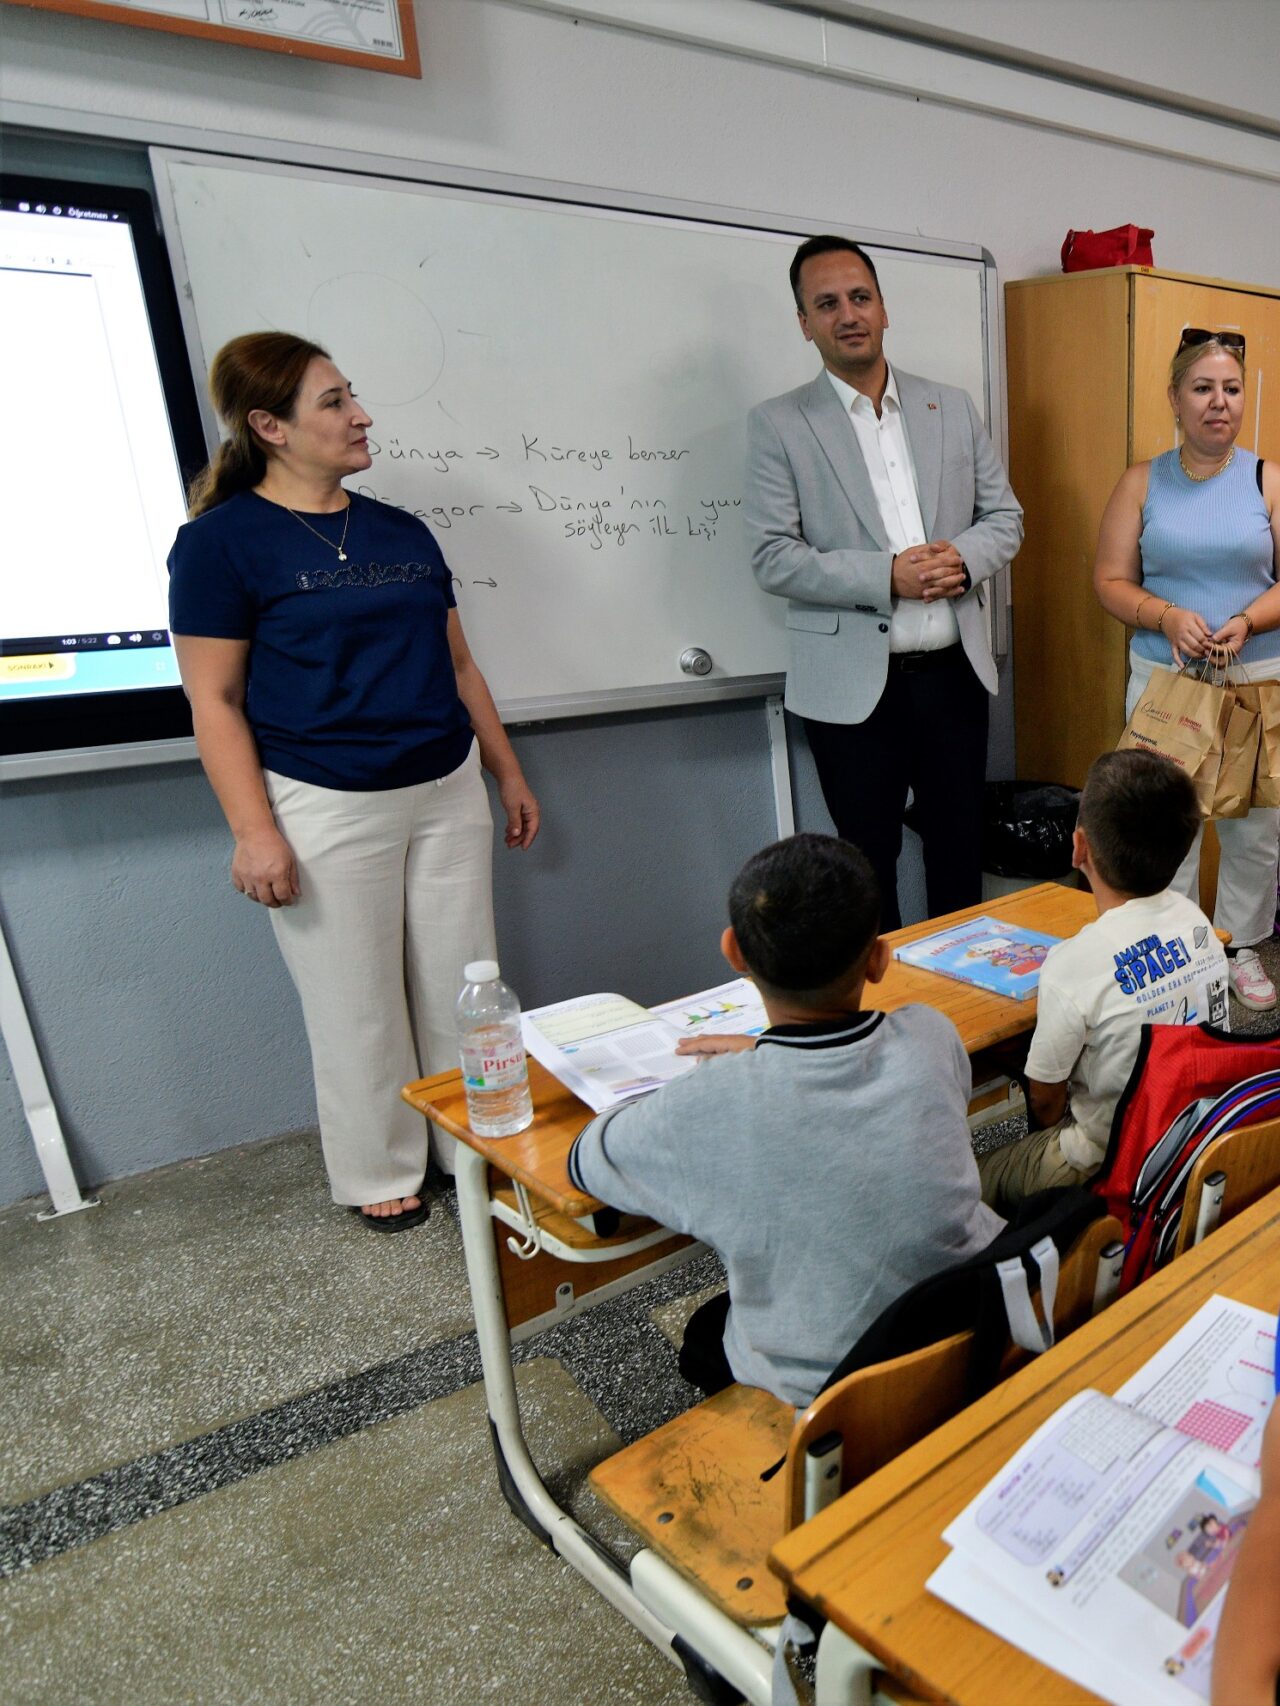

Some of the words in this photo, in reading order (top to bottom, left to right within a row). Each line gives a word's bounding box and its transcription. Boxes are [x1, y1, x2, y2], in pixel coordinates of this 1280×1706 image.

[628, 435, 690, 461] benzer
[1113, 934, 1161, 969] AMAZING
[1114, 936, 1191, 995] SPACE!
[1136, 985, 1167, 1004] GOLDEN
[1168, 979, 1181, 991] ERA
[1146, 1002, 1171, 1017] PLANET
[1170, 1000, 1175, 1008] X
